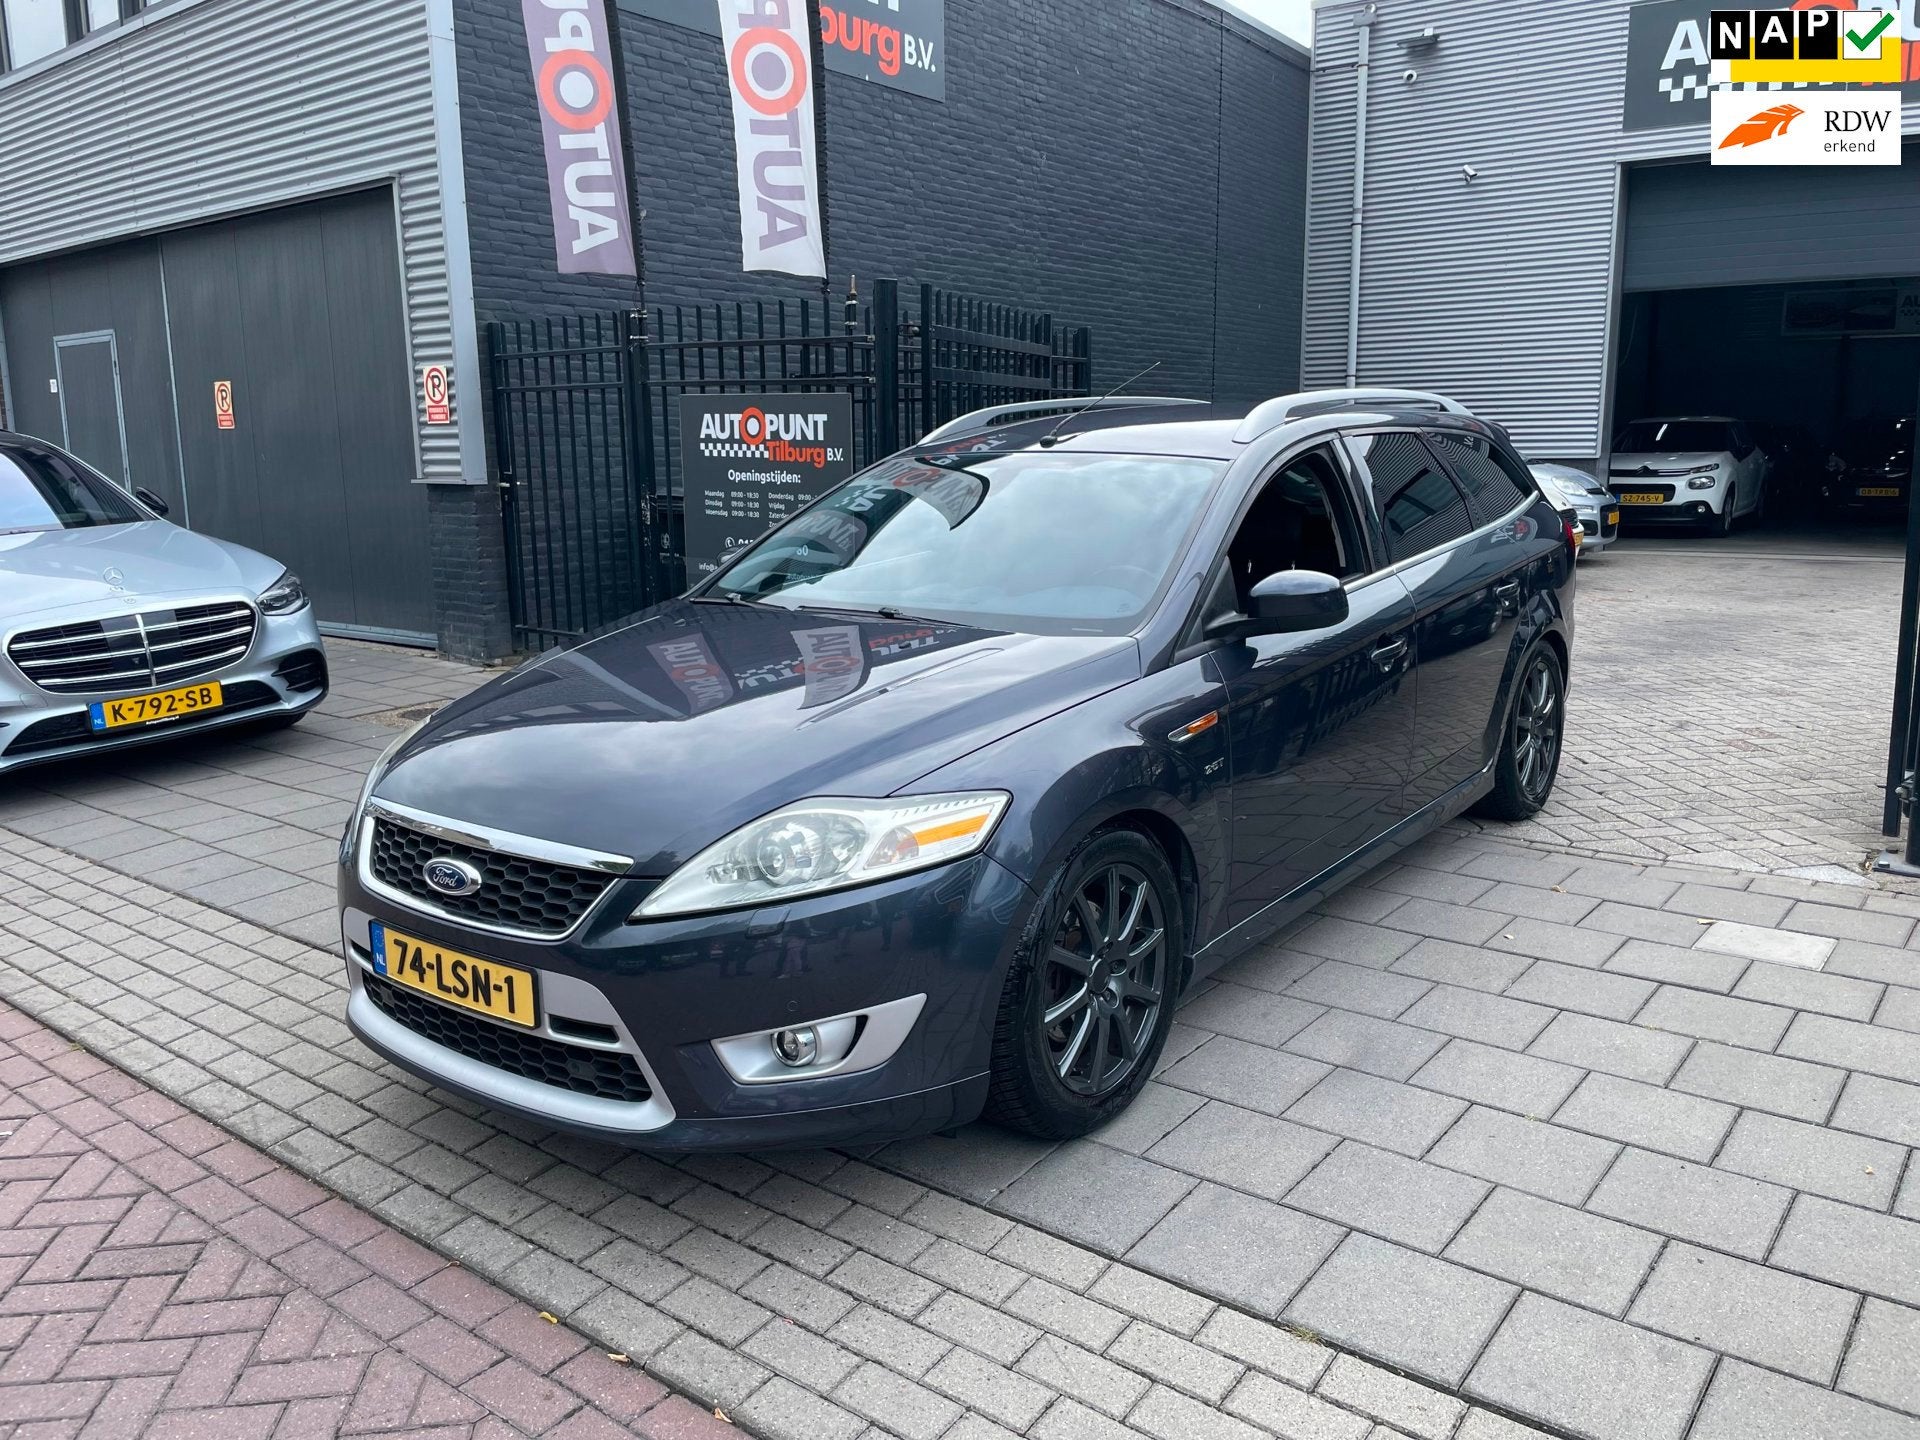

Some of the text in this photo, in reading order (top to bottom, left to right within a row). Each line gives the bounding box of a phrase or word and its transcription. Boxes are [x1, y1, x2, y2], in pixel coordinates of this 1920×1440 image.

[904, 33, 936, 72] B.V.
[699, 406, 828, 446] AUTOPUNT
[766, 441, 844, 469] Tilburg B.V.
[727, 469, 801, 485] Openingstijden:
[768, 492, 795, 501] Donderdag
[768, 502, 786, 511] Vrijdag
[111, 687, 213, 723] K-792-SB
[432, 866, 459, 887] Ford
[375, 938, 516, 1014] NL 74-LSN-1
